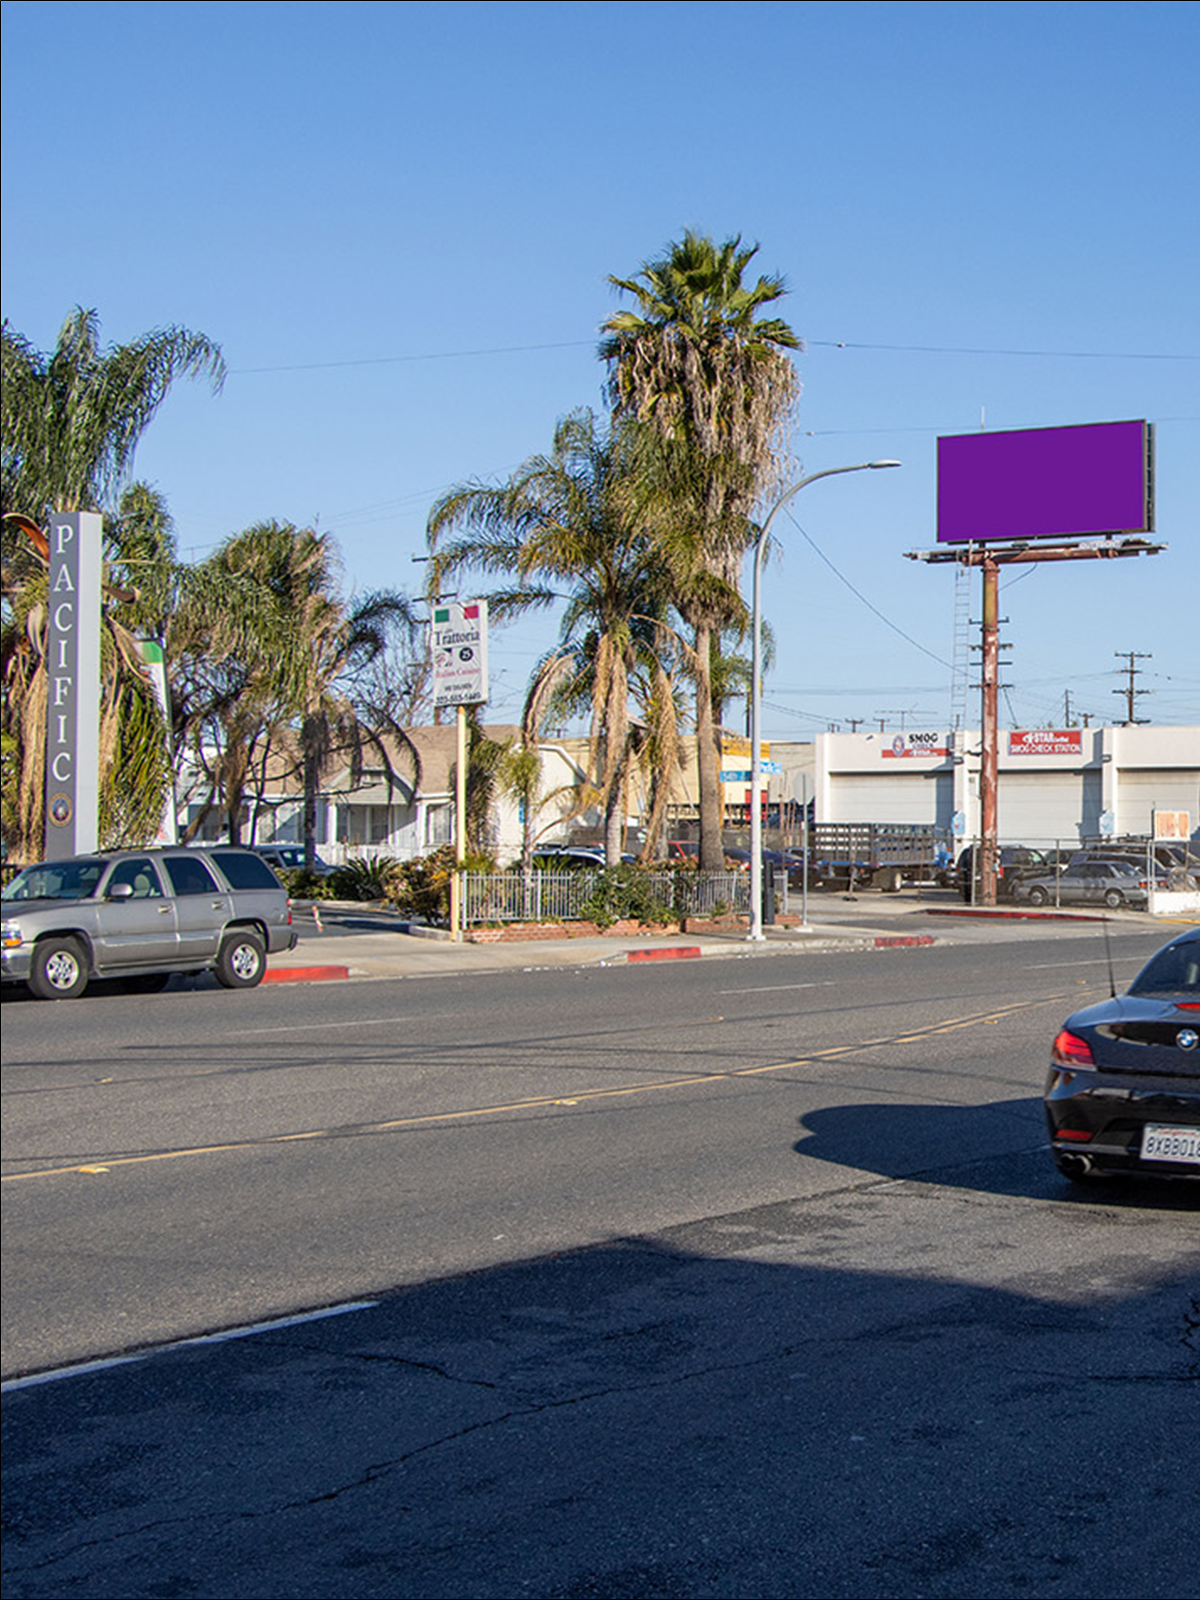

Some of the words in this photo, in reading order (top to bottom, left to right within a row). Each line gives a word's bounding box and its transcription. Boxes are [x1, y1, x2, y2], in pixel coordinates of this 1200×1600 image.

[435, 627, 480, 645] Trattoria
[52, 525, 75, 781] PACIFIC
[909, 733, 938, 743] SMOG
